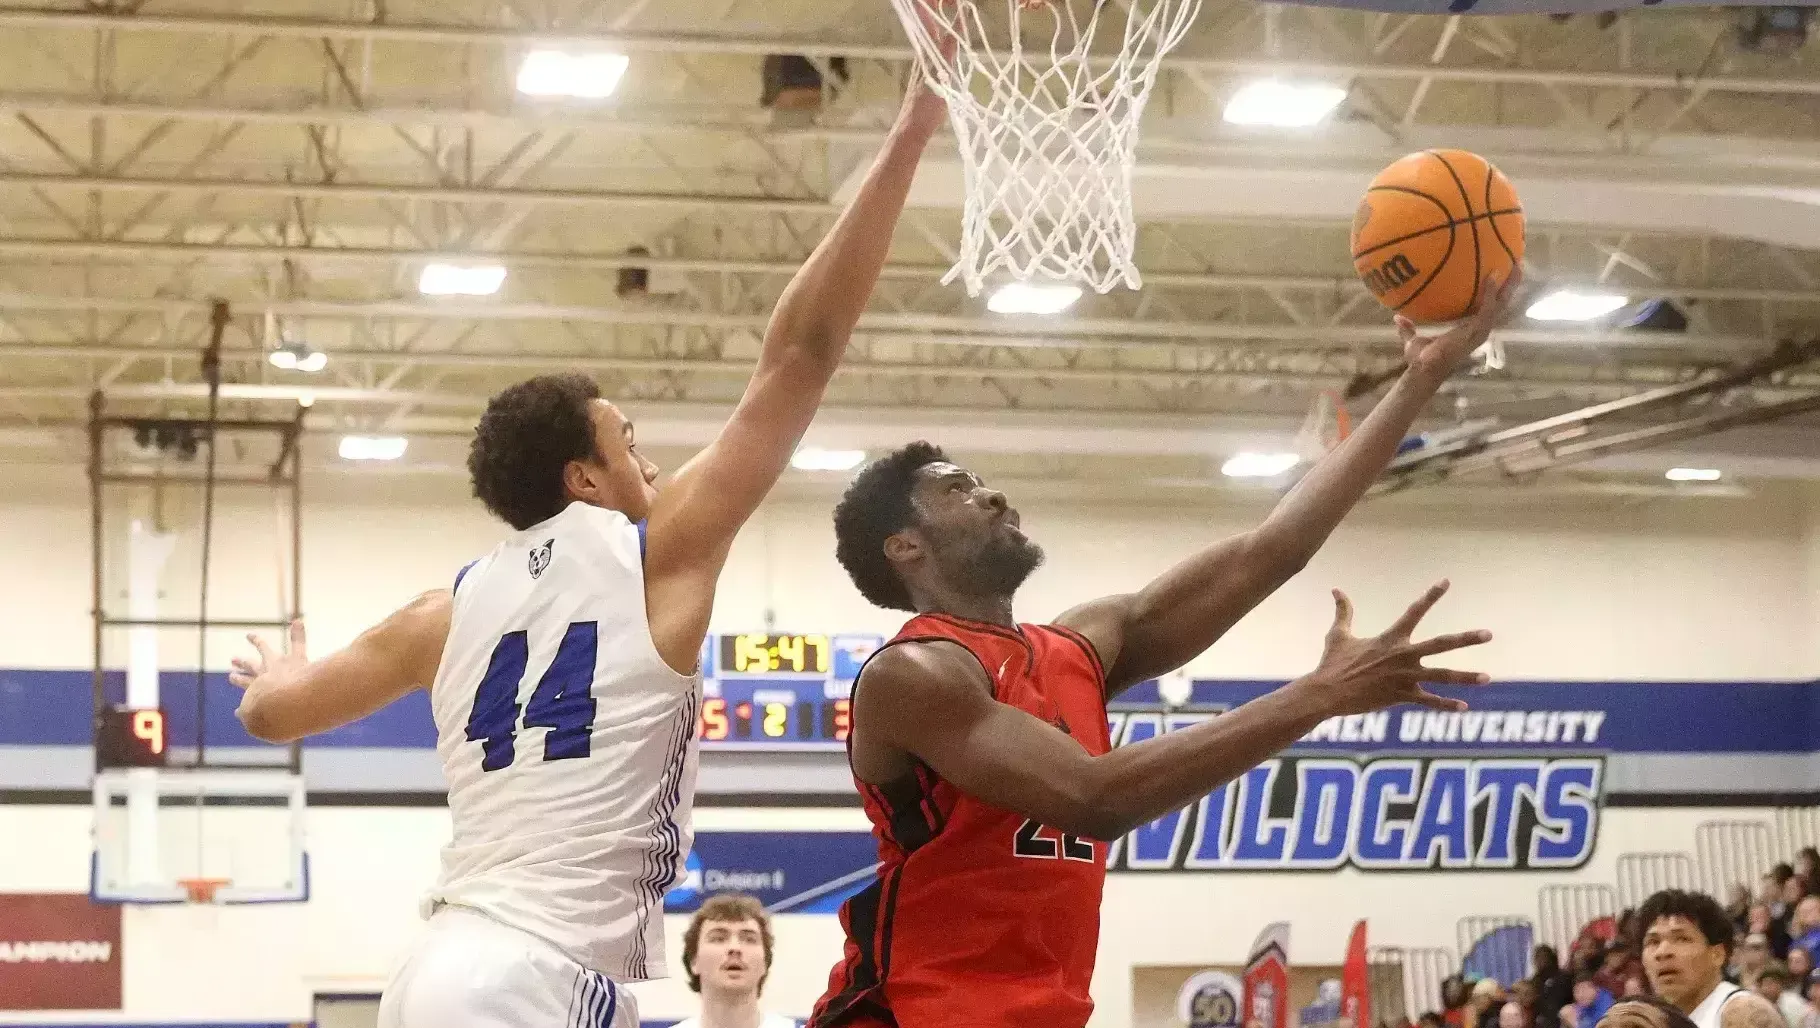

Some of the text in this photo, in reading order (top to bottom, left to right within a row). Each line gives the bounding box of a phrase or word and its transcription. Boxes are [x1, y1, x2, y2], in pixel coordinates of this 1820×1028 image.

[735, 634, 829, 673] 15:47
[464, 620, 598, 773] 44
[133, 710, 163, 754] 9
[698, 697, 730, 740] 5
[763, 701, 787, 737] 2
[1400, 710, 1605, 743] UNIVERSITY
